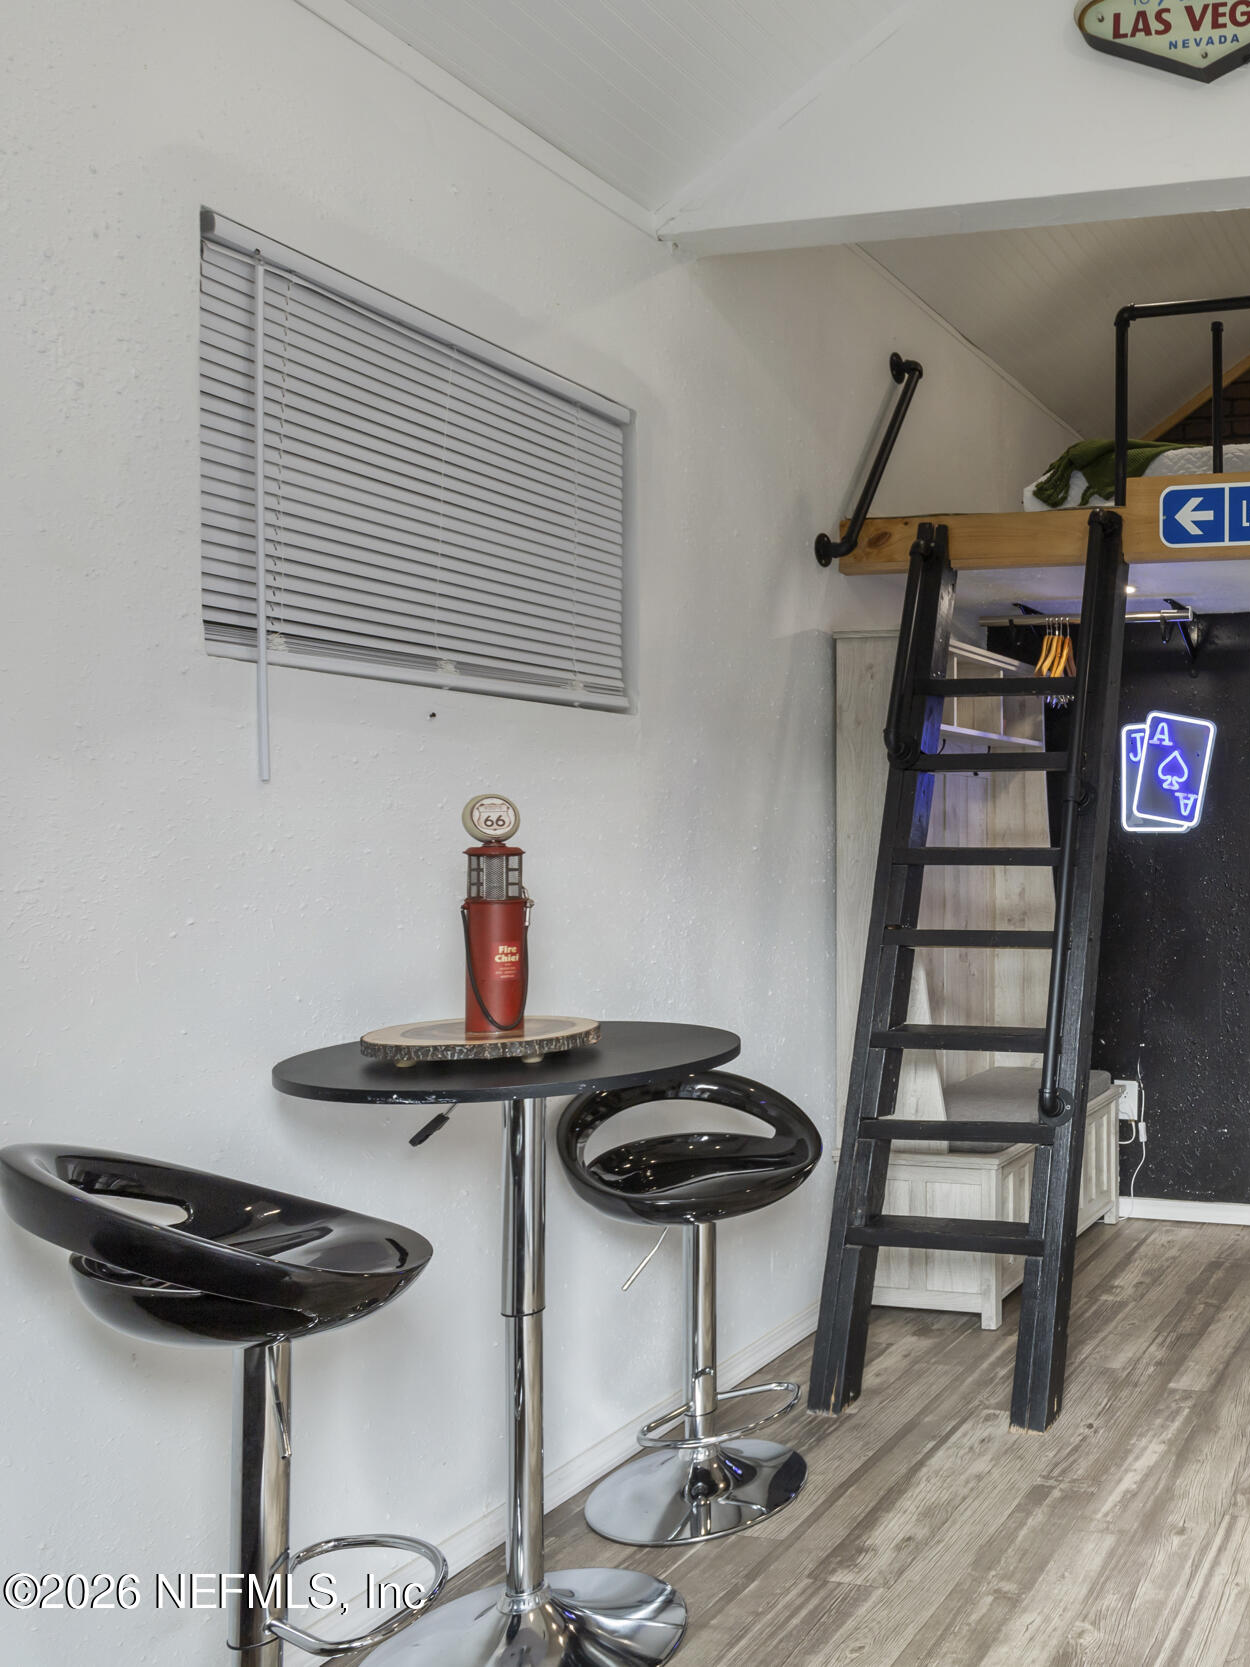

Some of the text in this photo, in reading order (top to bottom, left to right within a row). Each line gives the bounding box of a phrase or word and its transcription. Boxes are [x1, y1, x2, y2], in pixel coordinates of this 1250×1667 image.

[1112, 8, 1171, 39] LAS
[1168, 33, 1240, 50] NEVADA
[1149, 722, 1173, 746] A
[1129, 732, 1145, 762] J
[484, 815, 506, 827] 66
[494, 953, 520, 963] Chief
[498, 945, 517, 954] Fire
